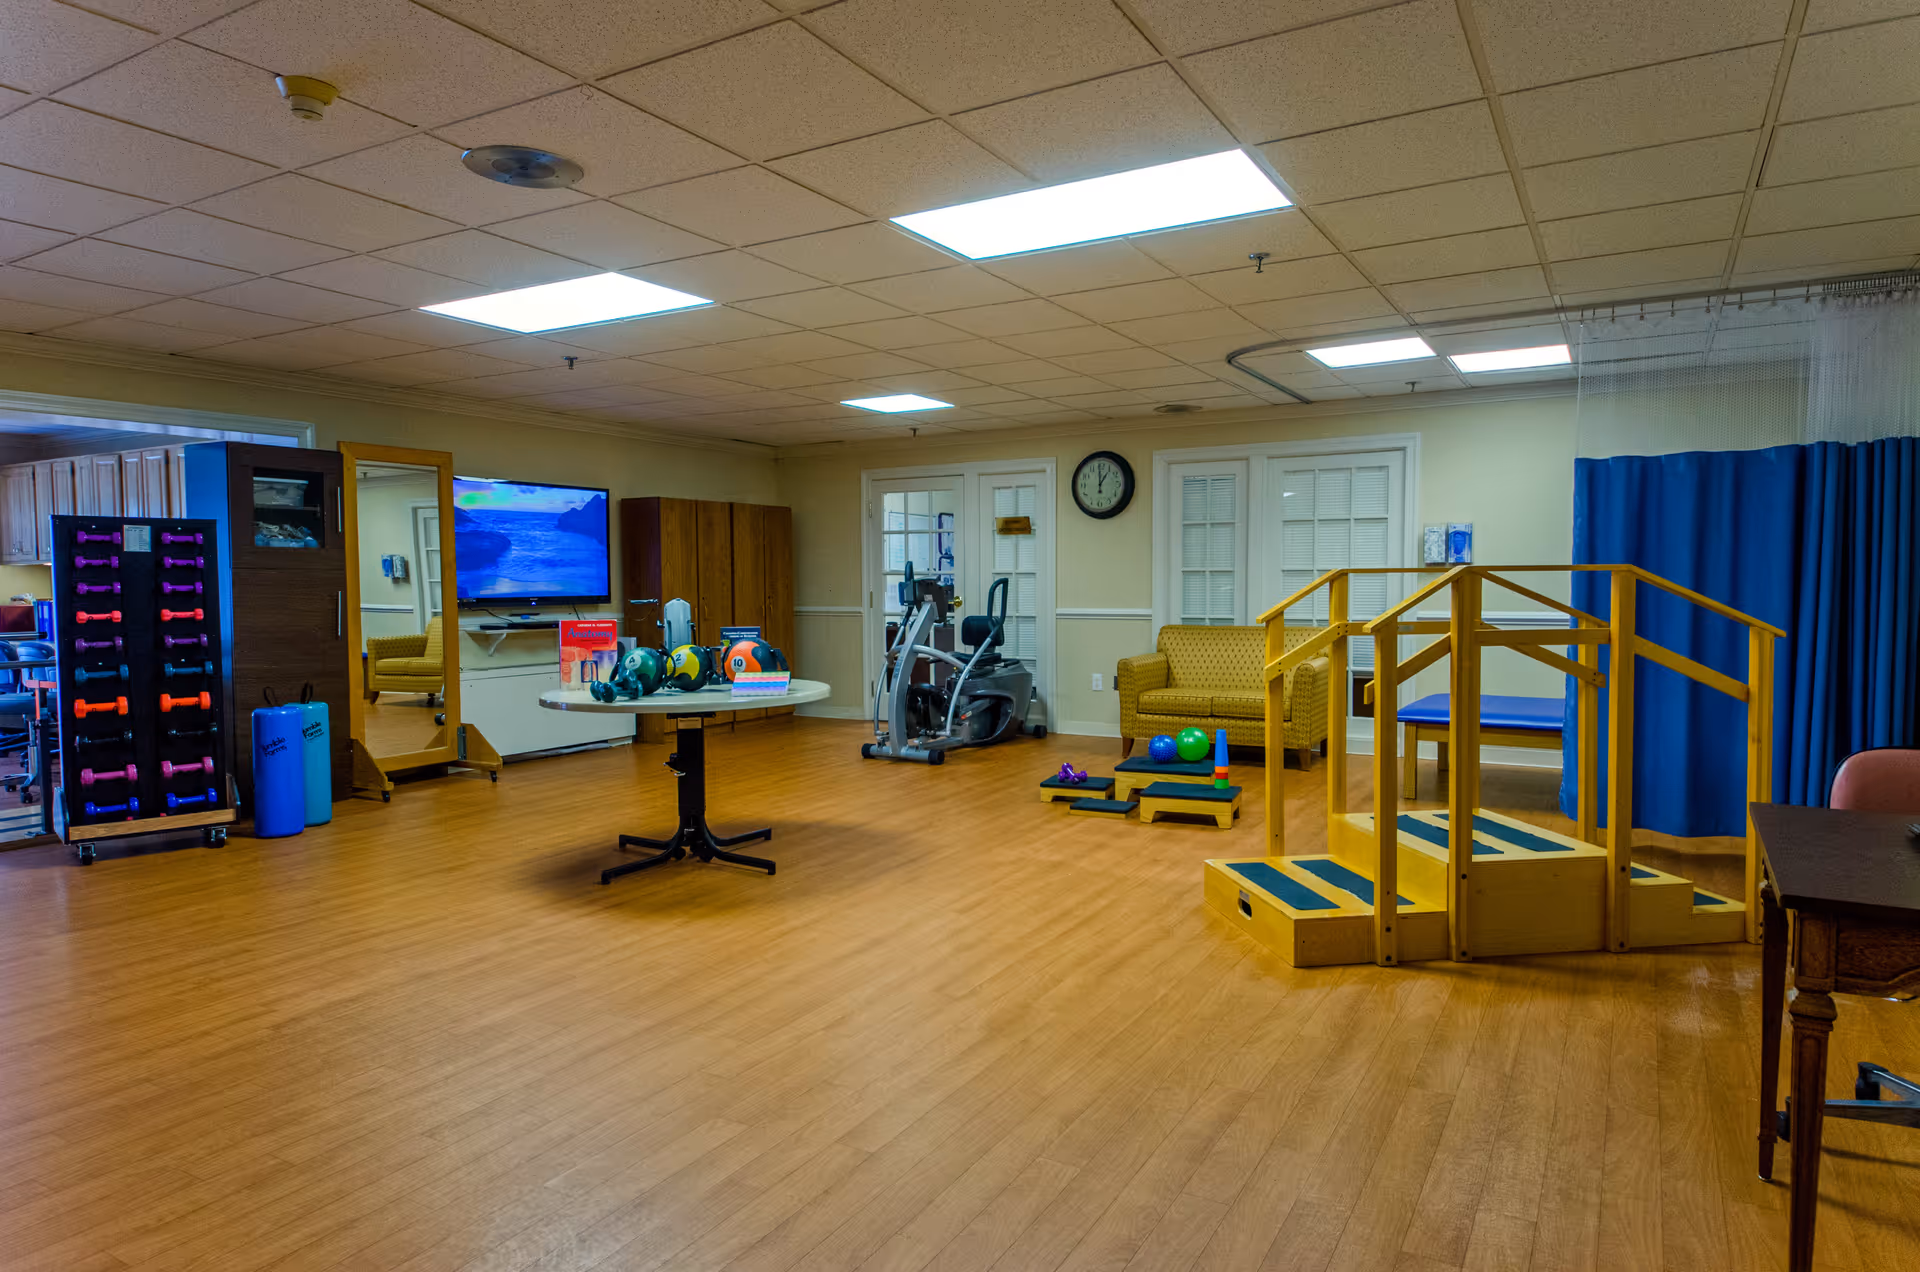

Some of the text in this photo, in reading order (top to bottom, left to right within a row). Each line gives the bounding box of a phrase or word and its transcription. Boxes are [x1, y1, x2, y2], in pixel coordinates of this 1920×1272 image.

[566, 627, 613, 642] Anatomy
[629, 656, 636, 664] 4
[675, 653, 682, 662] 2
[733, 658, 743, 668] 10
[302, 721, 322, 735] umble
